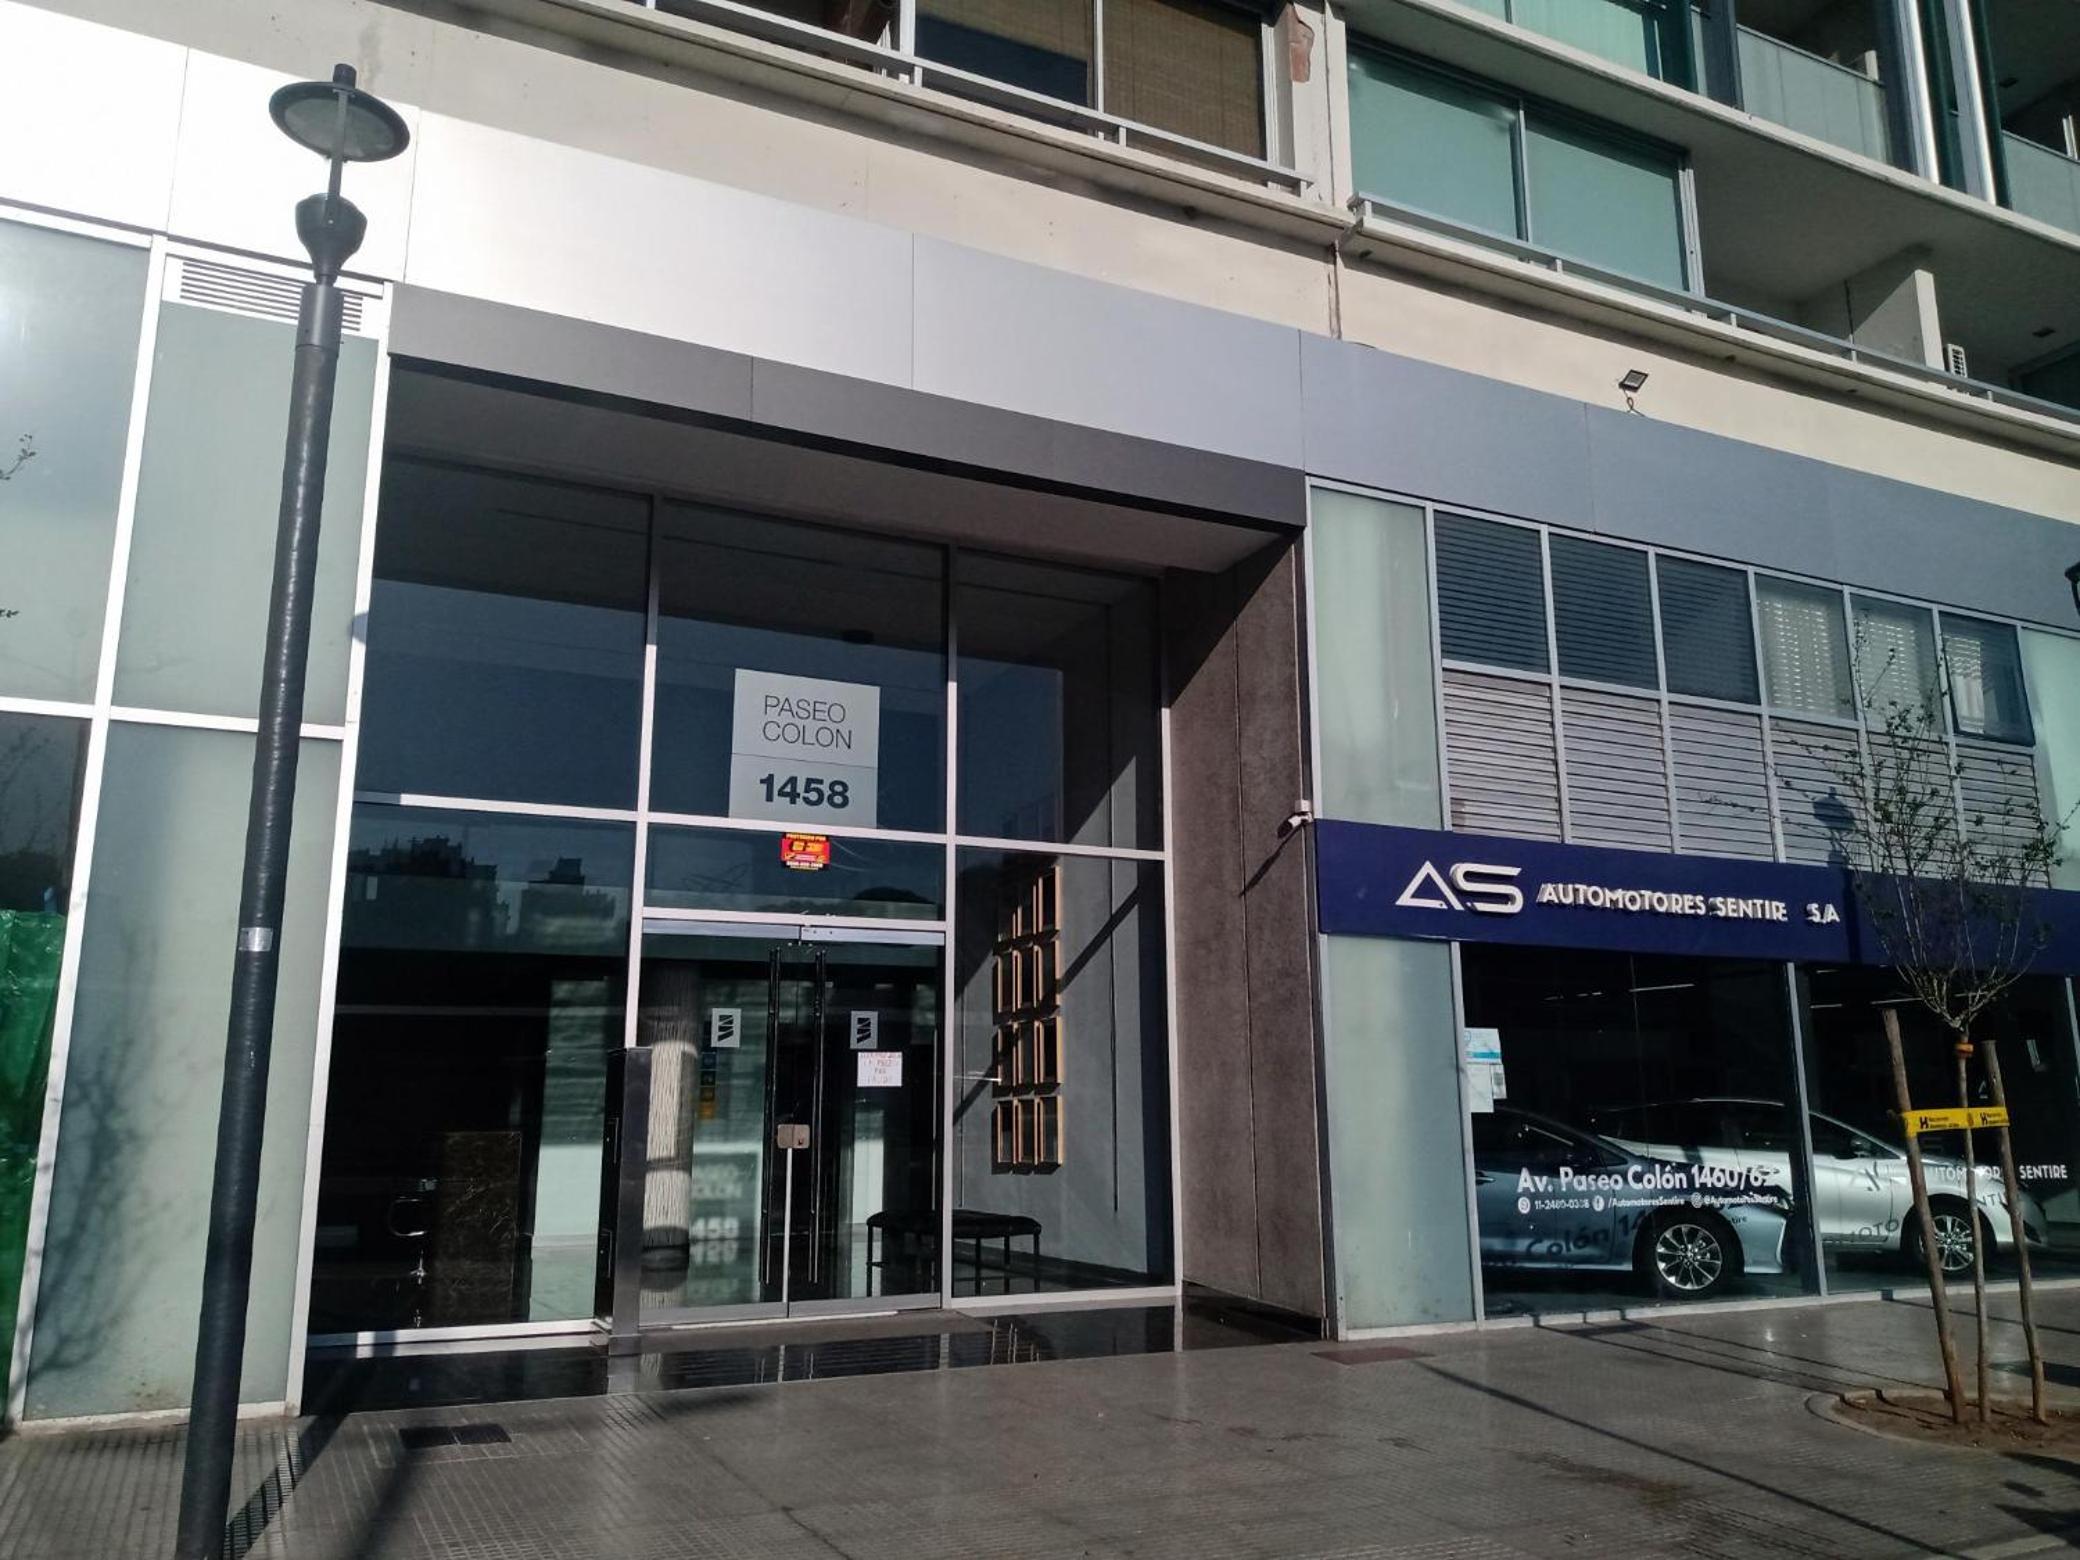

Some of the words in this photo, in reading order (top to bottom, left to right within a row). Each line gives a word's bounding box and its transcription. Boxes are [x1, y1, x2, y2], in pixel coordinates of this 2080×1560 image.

[764, 694, 846, 723] PASEO
[762, 720, 852, 749] COLON
[759, 773, 850, 809] 1458
[1395, 860, 1523, 914] AS
[1536, 883, 1706, 916] AUTOMOTORES
[1709, 896, 1788, 921] SENTIRE
[1517, 1166, 1554, 1193] Av.
[1559, 1165, 1624, 1192] Paseo
[1627, 1163, 1688, 1190] Colón
[2020, 1164, 2069, 1180] SENTIRE
